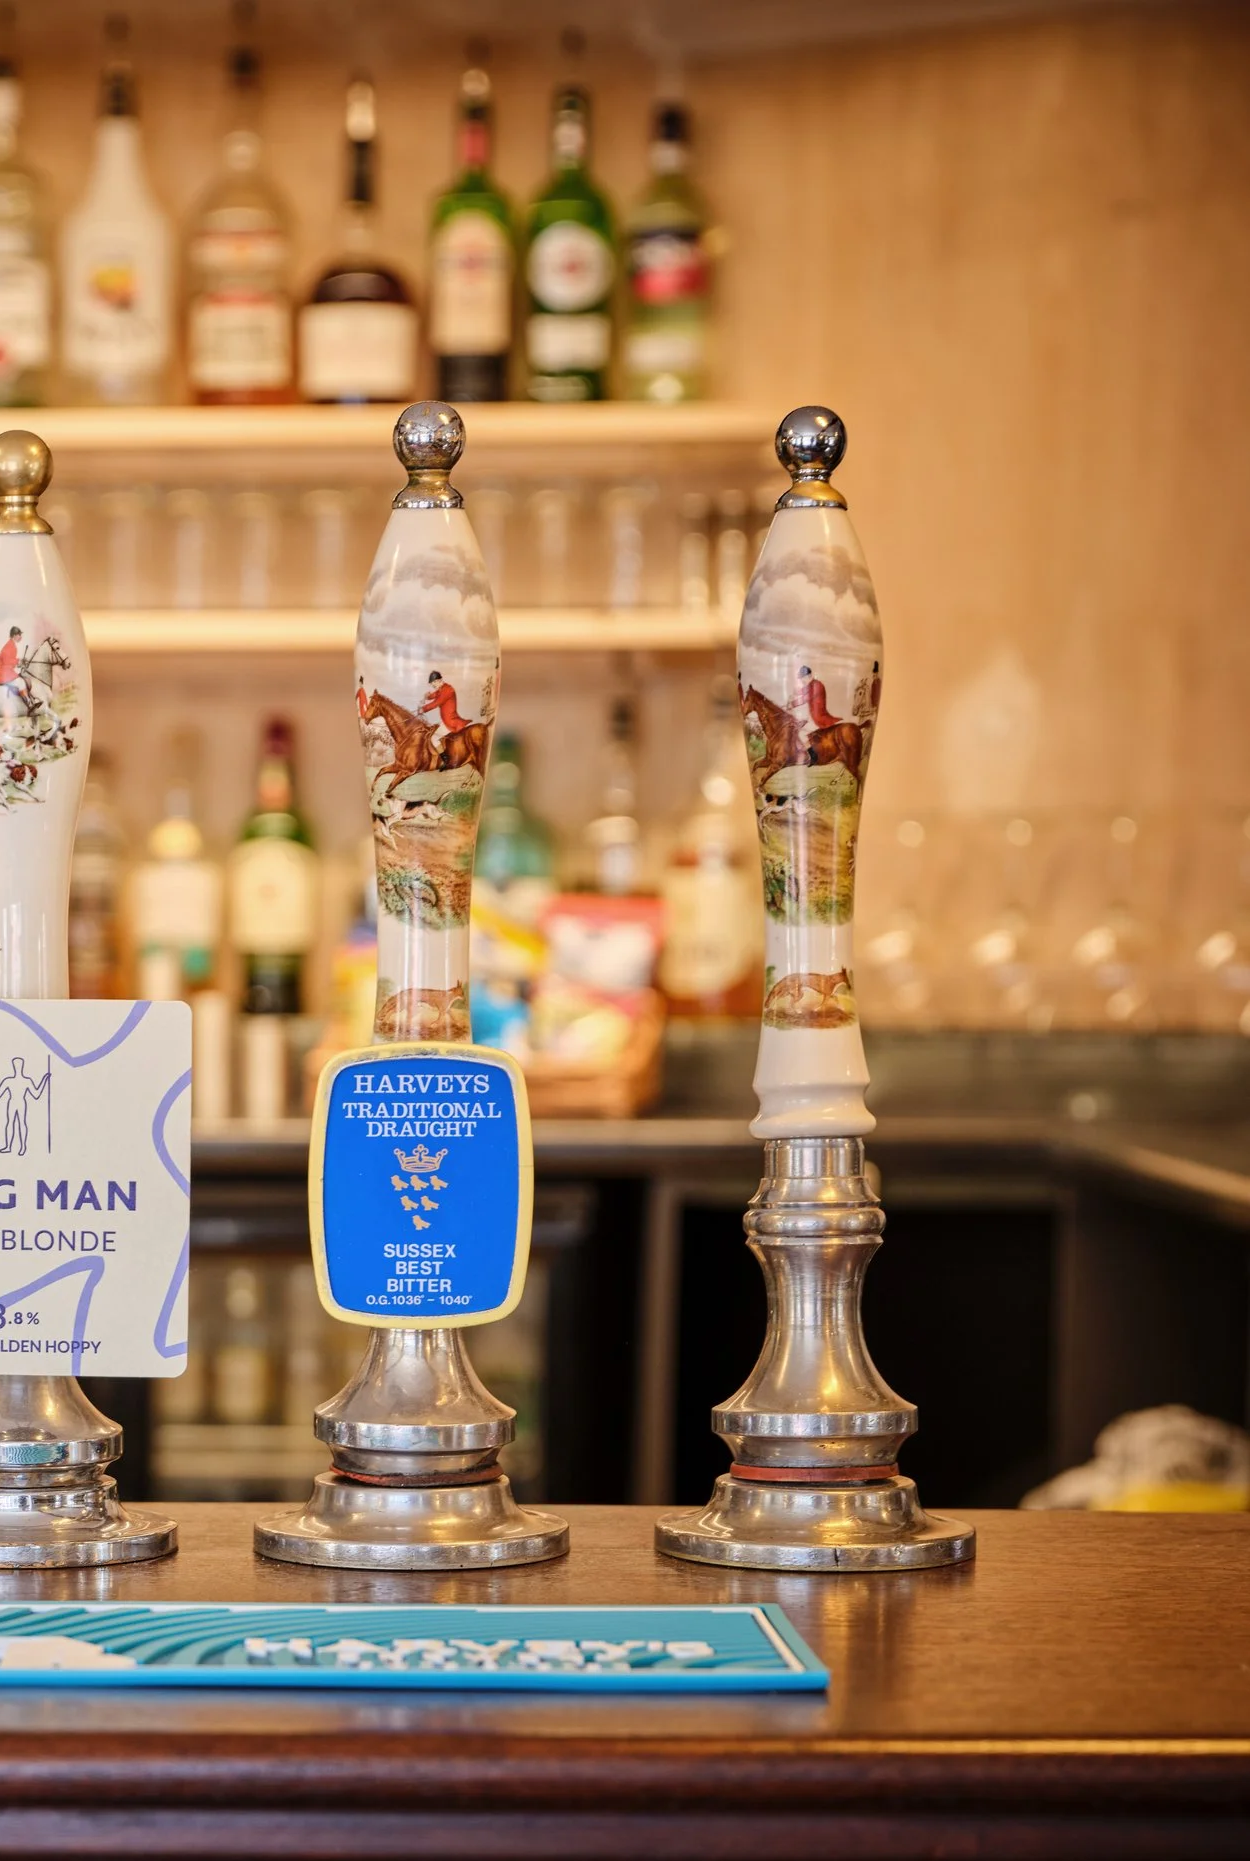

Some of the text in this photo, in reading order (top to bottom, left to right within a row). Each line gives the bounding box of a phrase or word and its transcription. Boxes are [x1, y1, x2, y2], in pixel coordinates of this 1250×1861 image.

[353, 1074, 490, 1094] HARVEYS
[342, 1102, 502, 1119] TRADITIONAL
[366, 1121, 477, 1138] DRAUGHT
[36, 1179, 138, 1212] MAN
[1, 1229, 117, 1252] BLONDE
[383, 1243, 457, 1259] SUSSEX
[395, 1260, 444, 1276] BEST
[386, 1278, 453, 1293] BITTER
[45, 1340, 102, 1355] HOPPY
